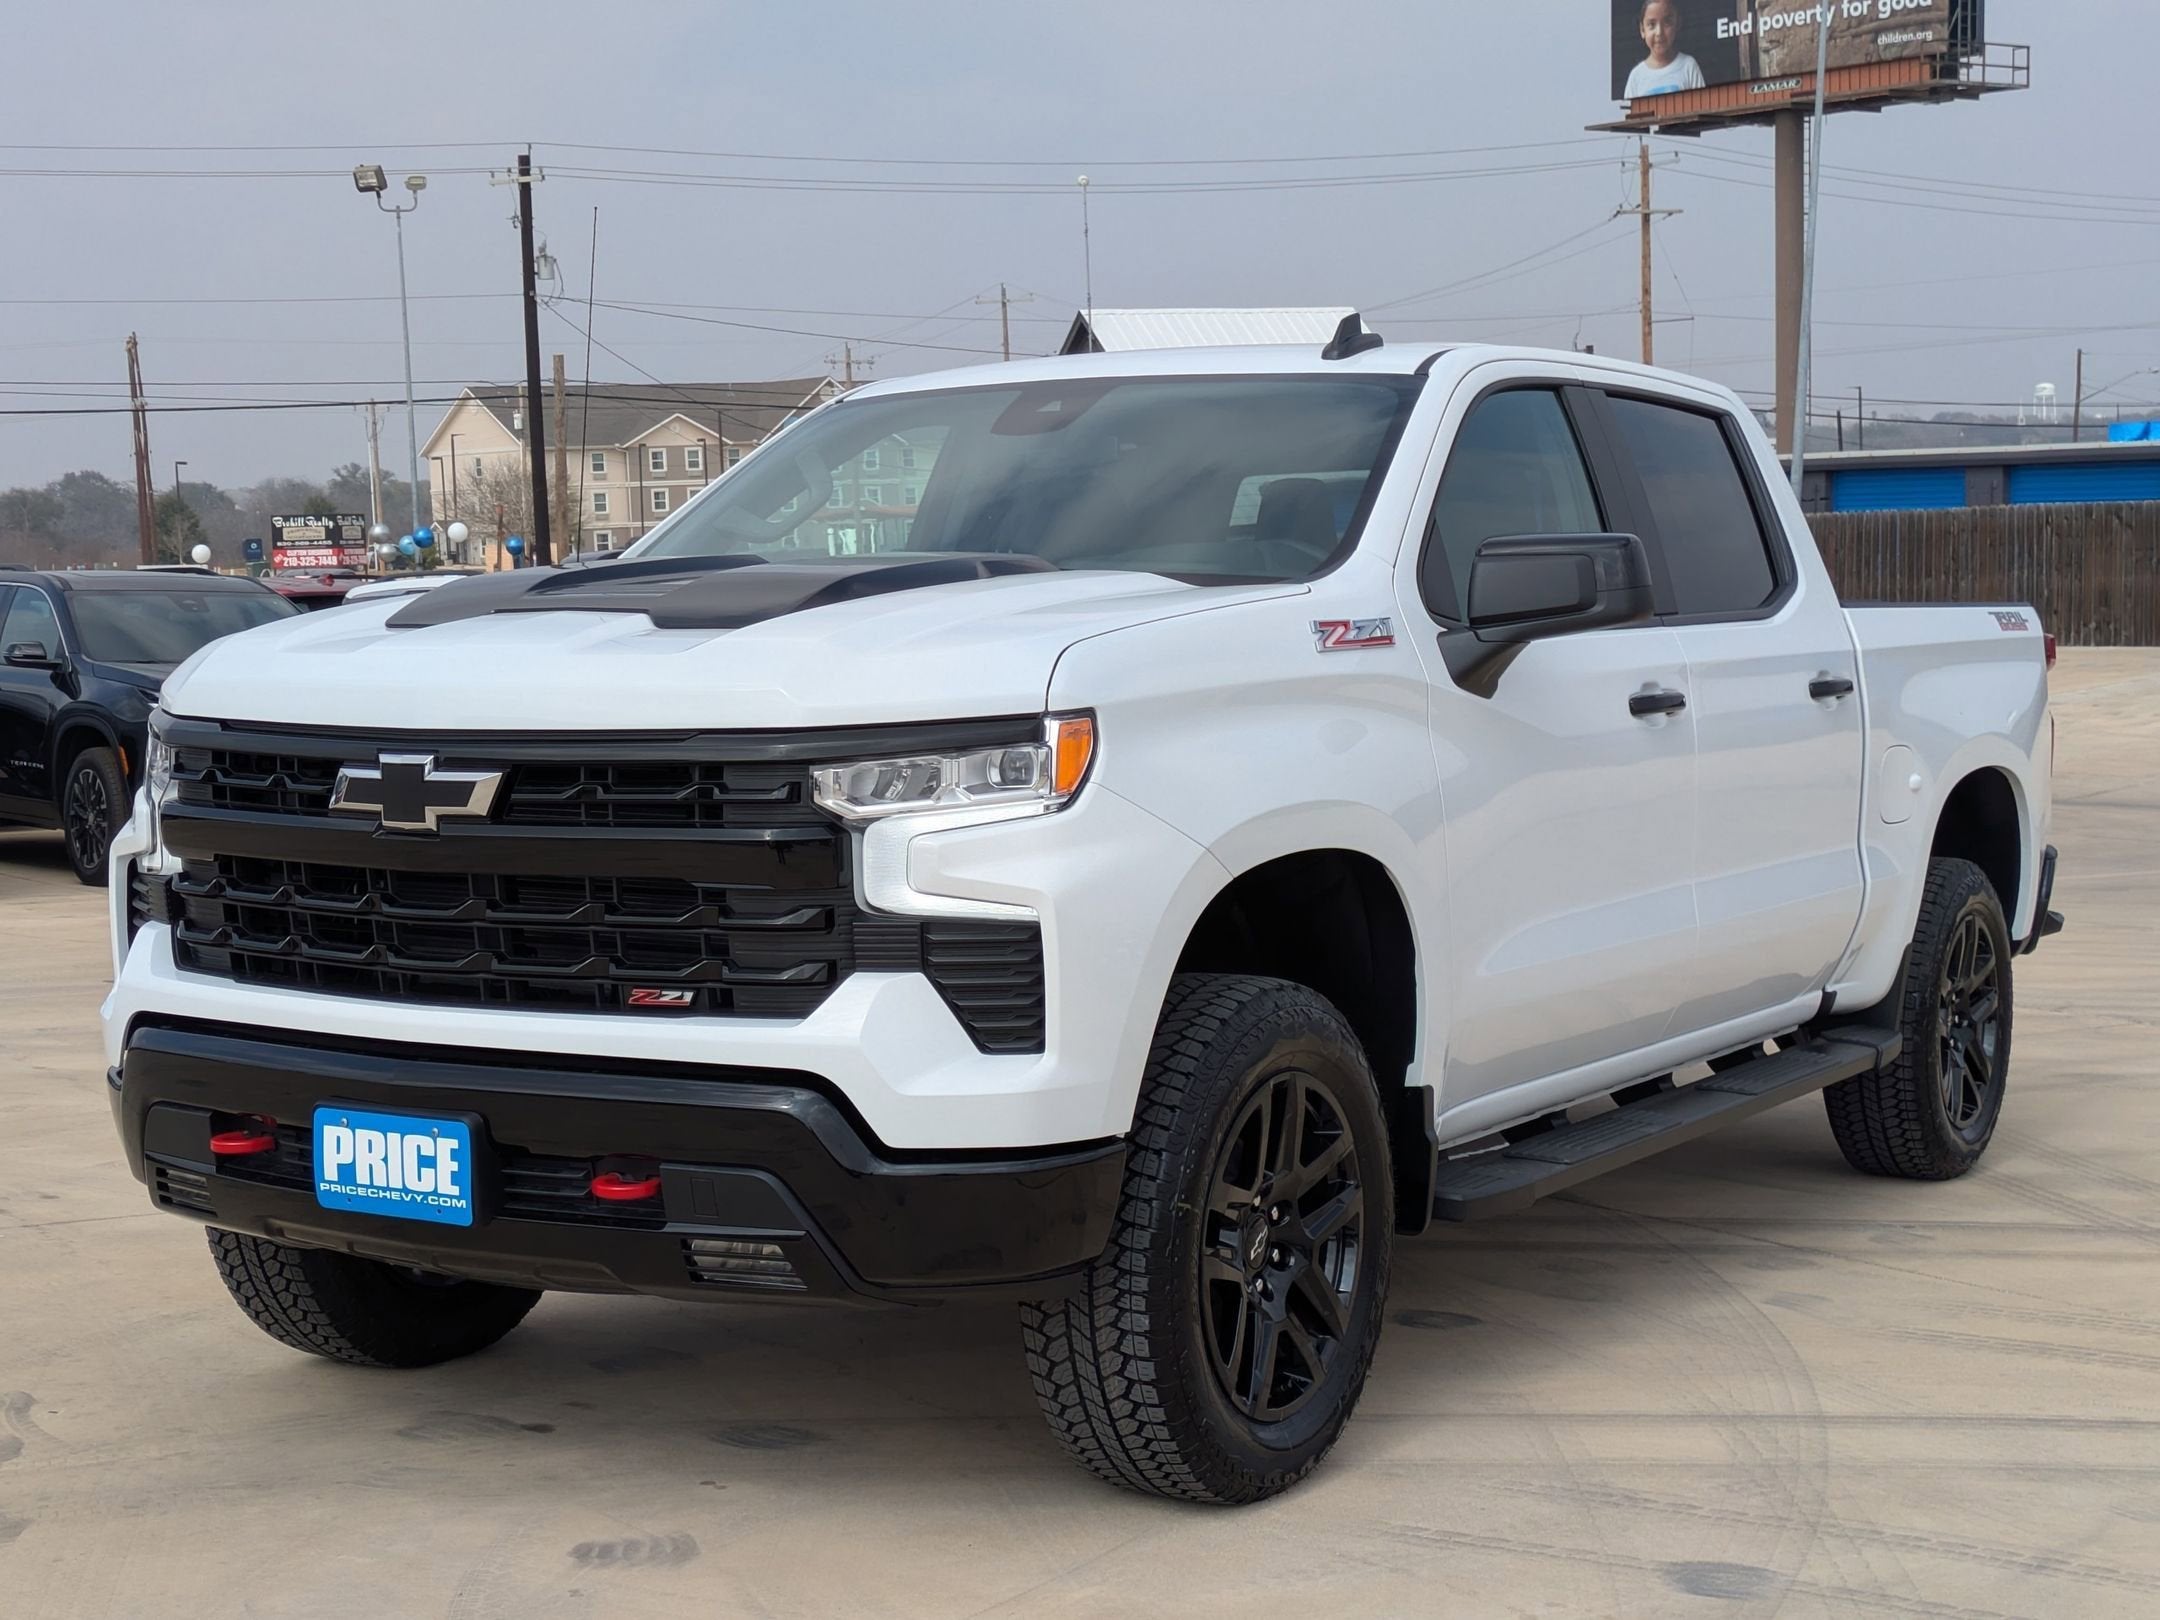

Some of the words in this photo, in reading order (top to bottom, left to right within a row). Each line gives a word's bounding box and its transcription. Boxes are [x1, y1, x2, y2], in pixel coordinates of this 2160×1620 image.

[1717, 12, 1752, 39] End
[1759, 4, 1835, 37] poverty
[1841, 0, 1871, 18] for
[1877, 30, 1933, 45] children.org
[1753, 80, 1797, 92] LAMAR
[1987, 611, 2029, 624] TRAIL
[1309, 616, 1396, 653] Z71
[628, 988, 694, 1006] Z71
[323, 1125, 460, 1196] PRICE
[319, 1182, 467, 1209] PRICECHEVY.COM
